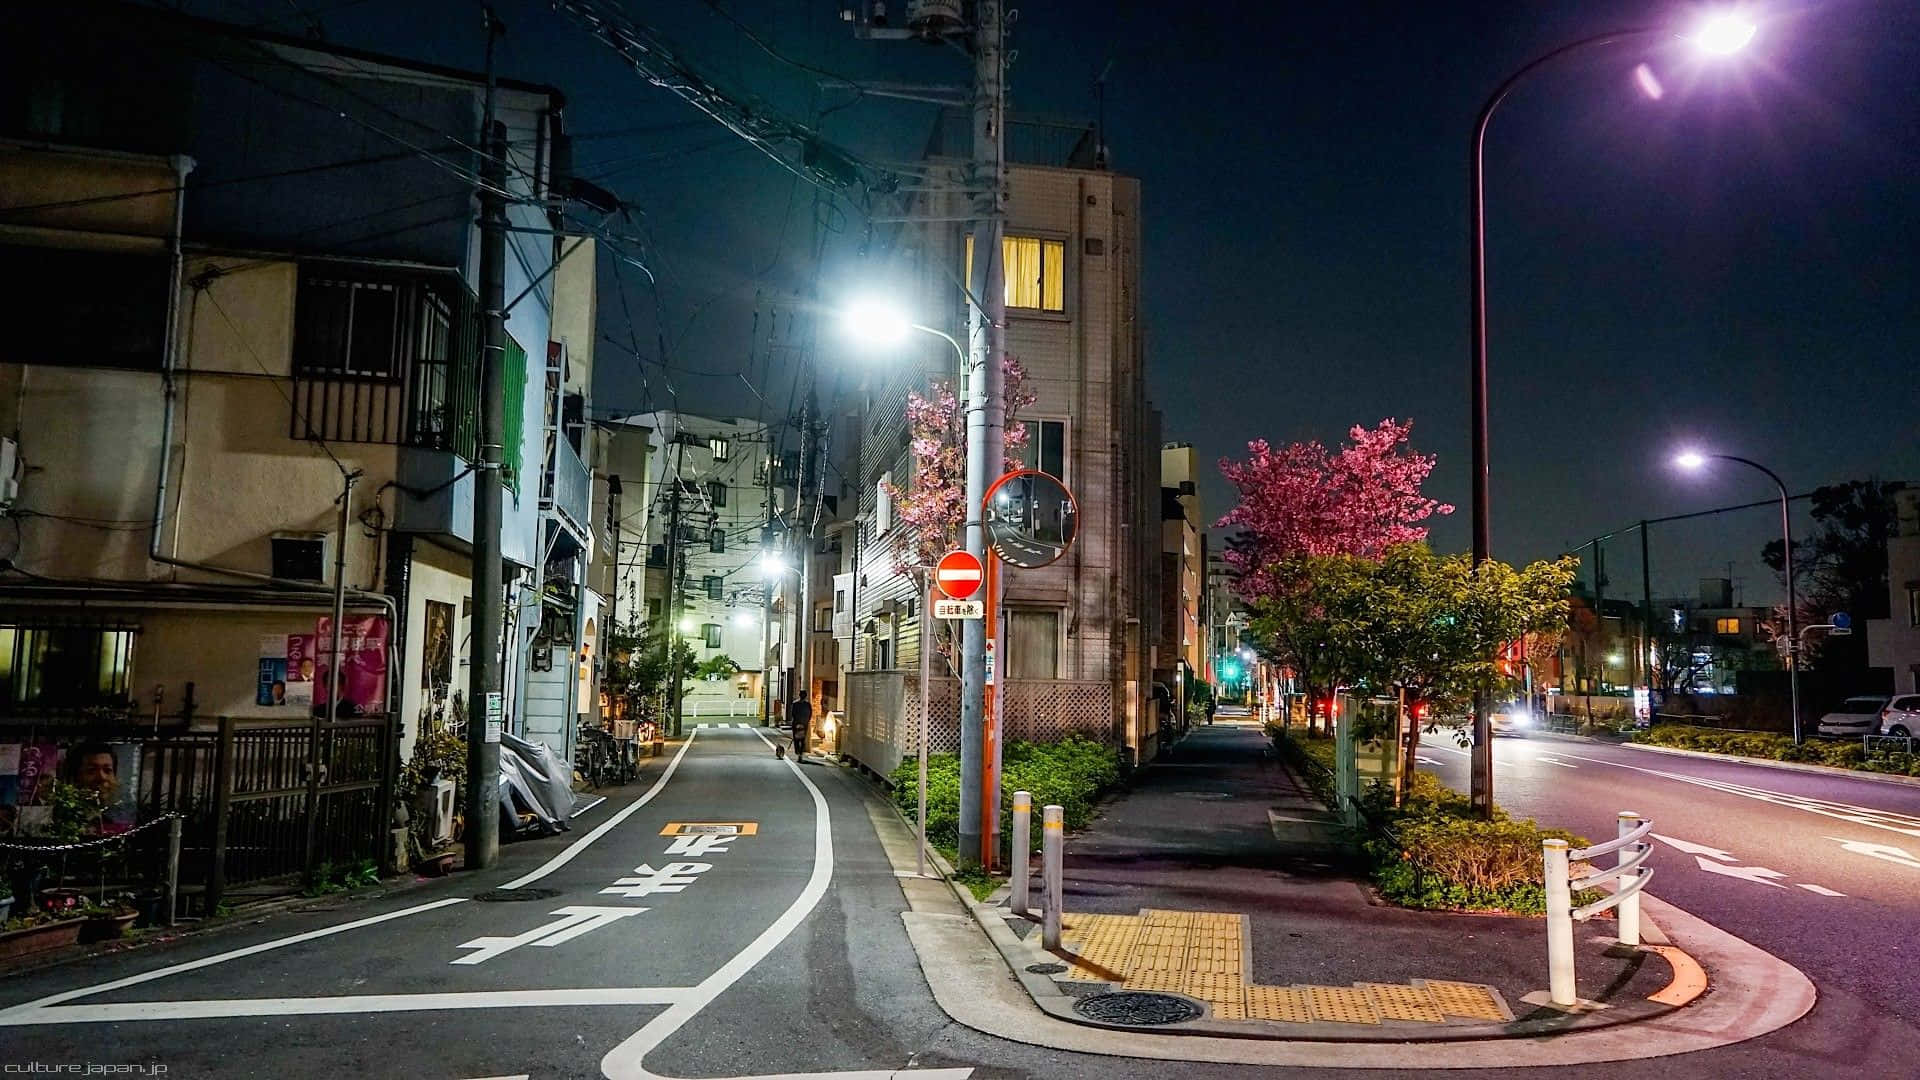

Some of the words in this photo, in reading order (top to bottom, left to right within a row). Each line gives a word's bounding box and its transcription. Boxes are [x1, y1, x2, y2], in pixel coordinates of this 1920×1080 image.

[939, 604, 979, 616] 自転車を除く
